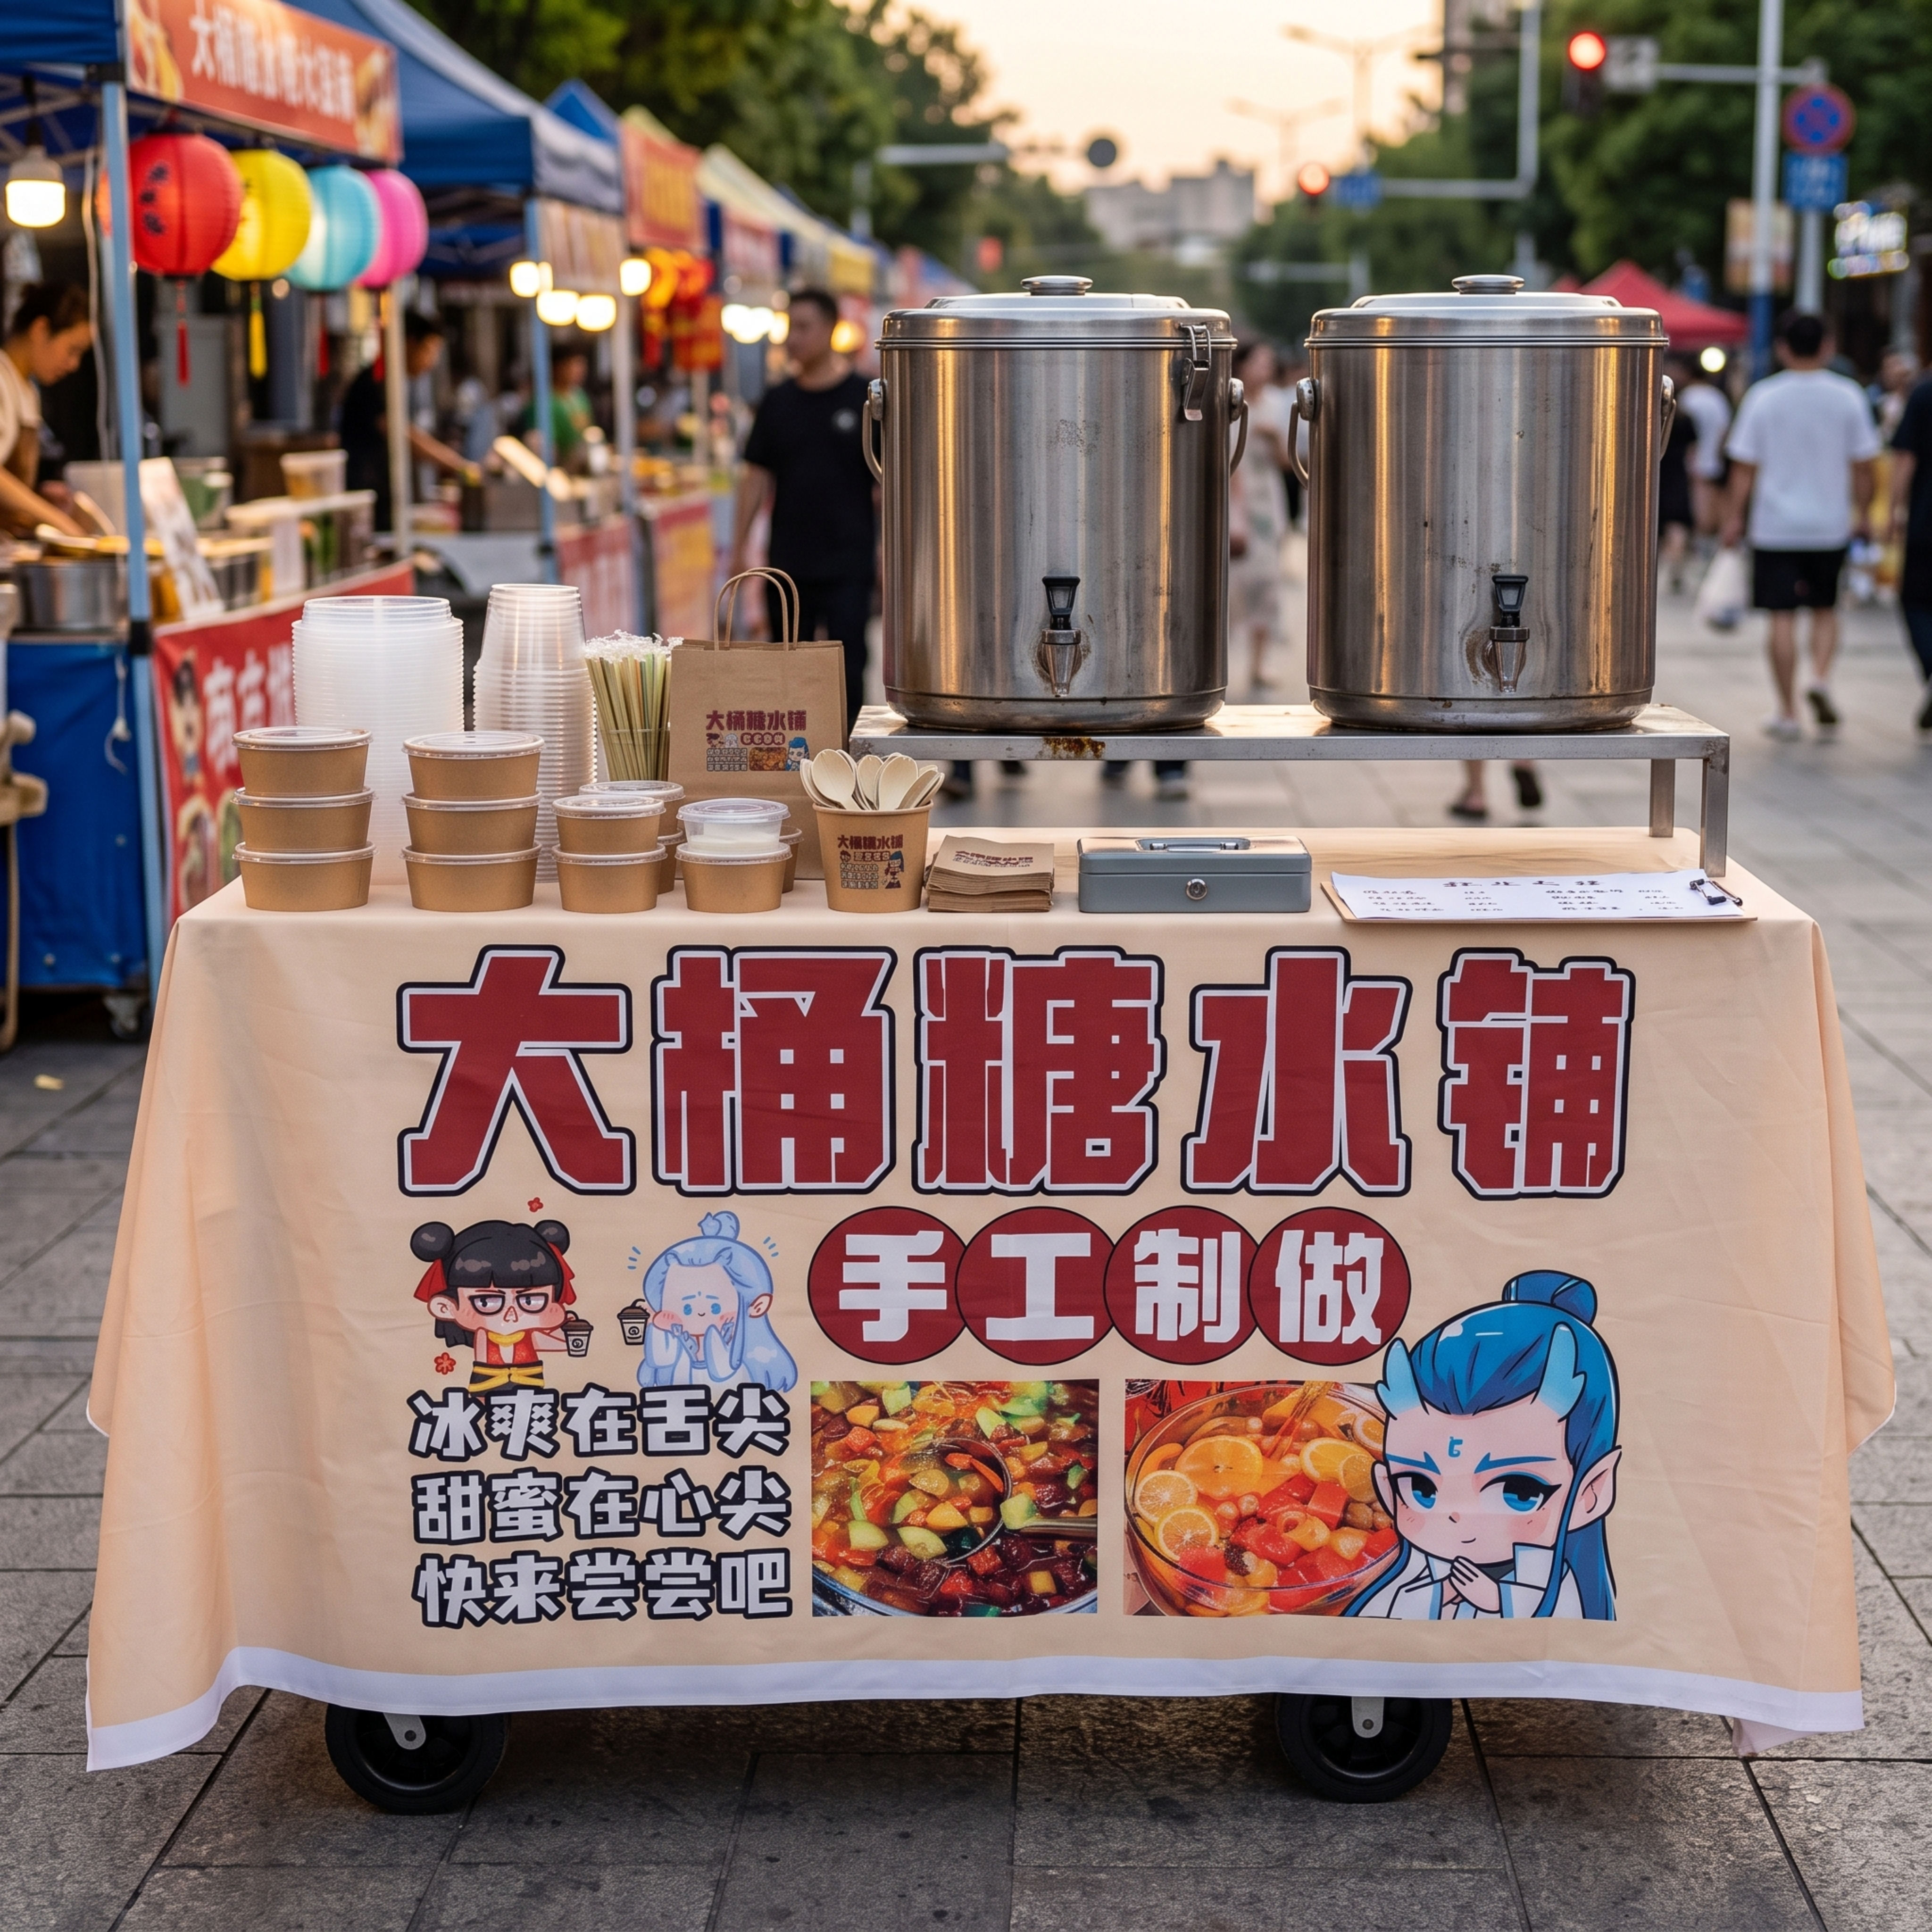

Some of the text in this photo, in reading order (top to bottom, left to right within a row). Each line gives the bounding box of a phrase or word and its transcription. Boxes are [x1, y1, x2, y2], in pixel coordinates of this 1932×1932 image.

[396, 945, 1636, 1200] 大桶糖水铺
[839, 1228, 1384, 1345] 手工制做
[406, 1382, 791, 1461] 冰爽在舌尖
[410, 1466, 792, 1545] 甜蜜在心尖
[411, 1547, 793, 1630] 快来尝尝吧
